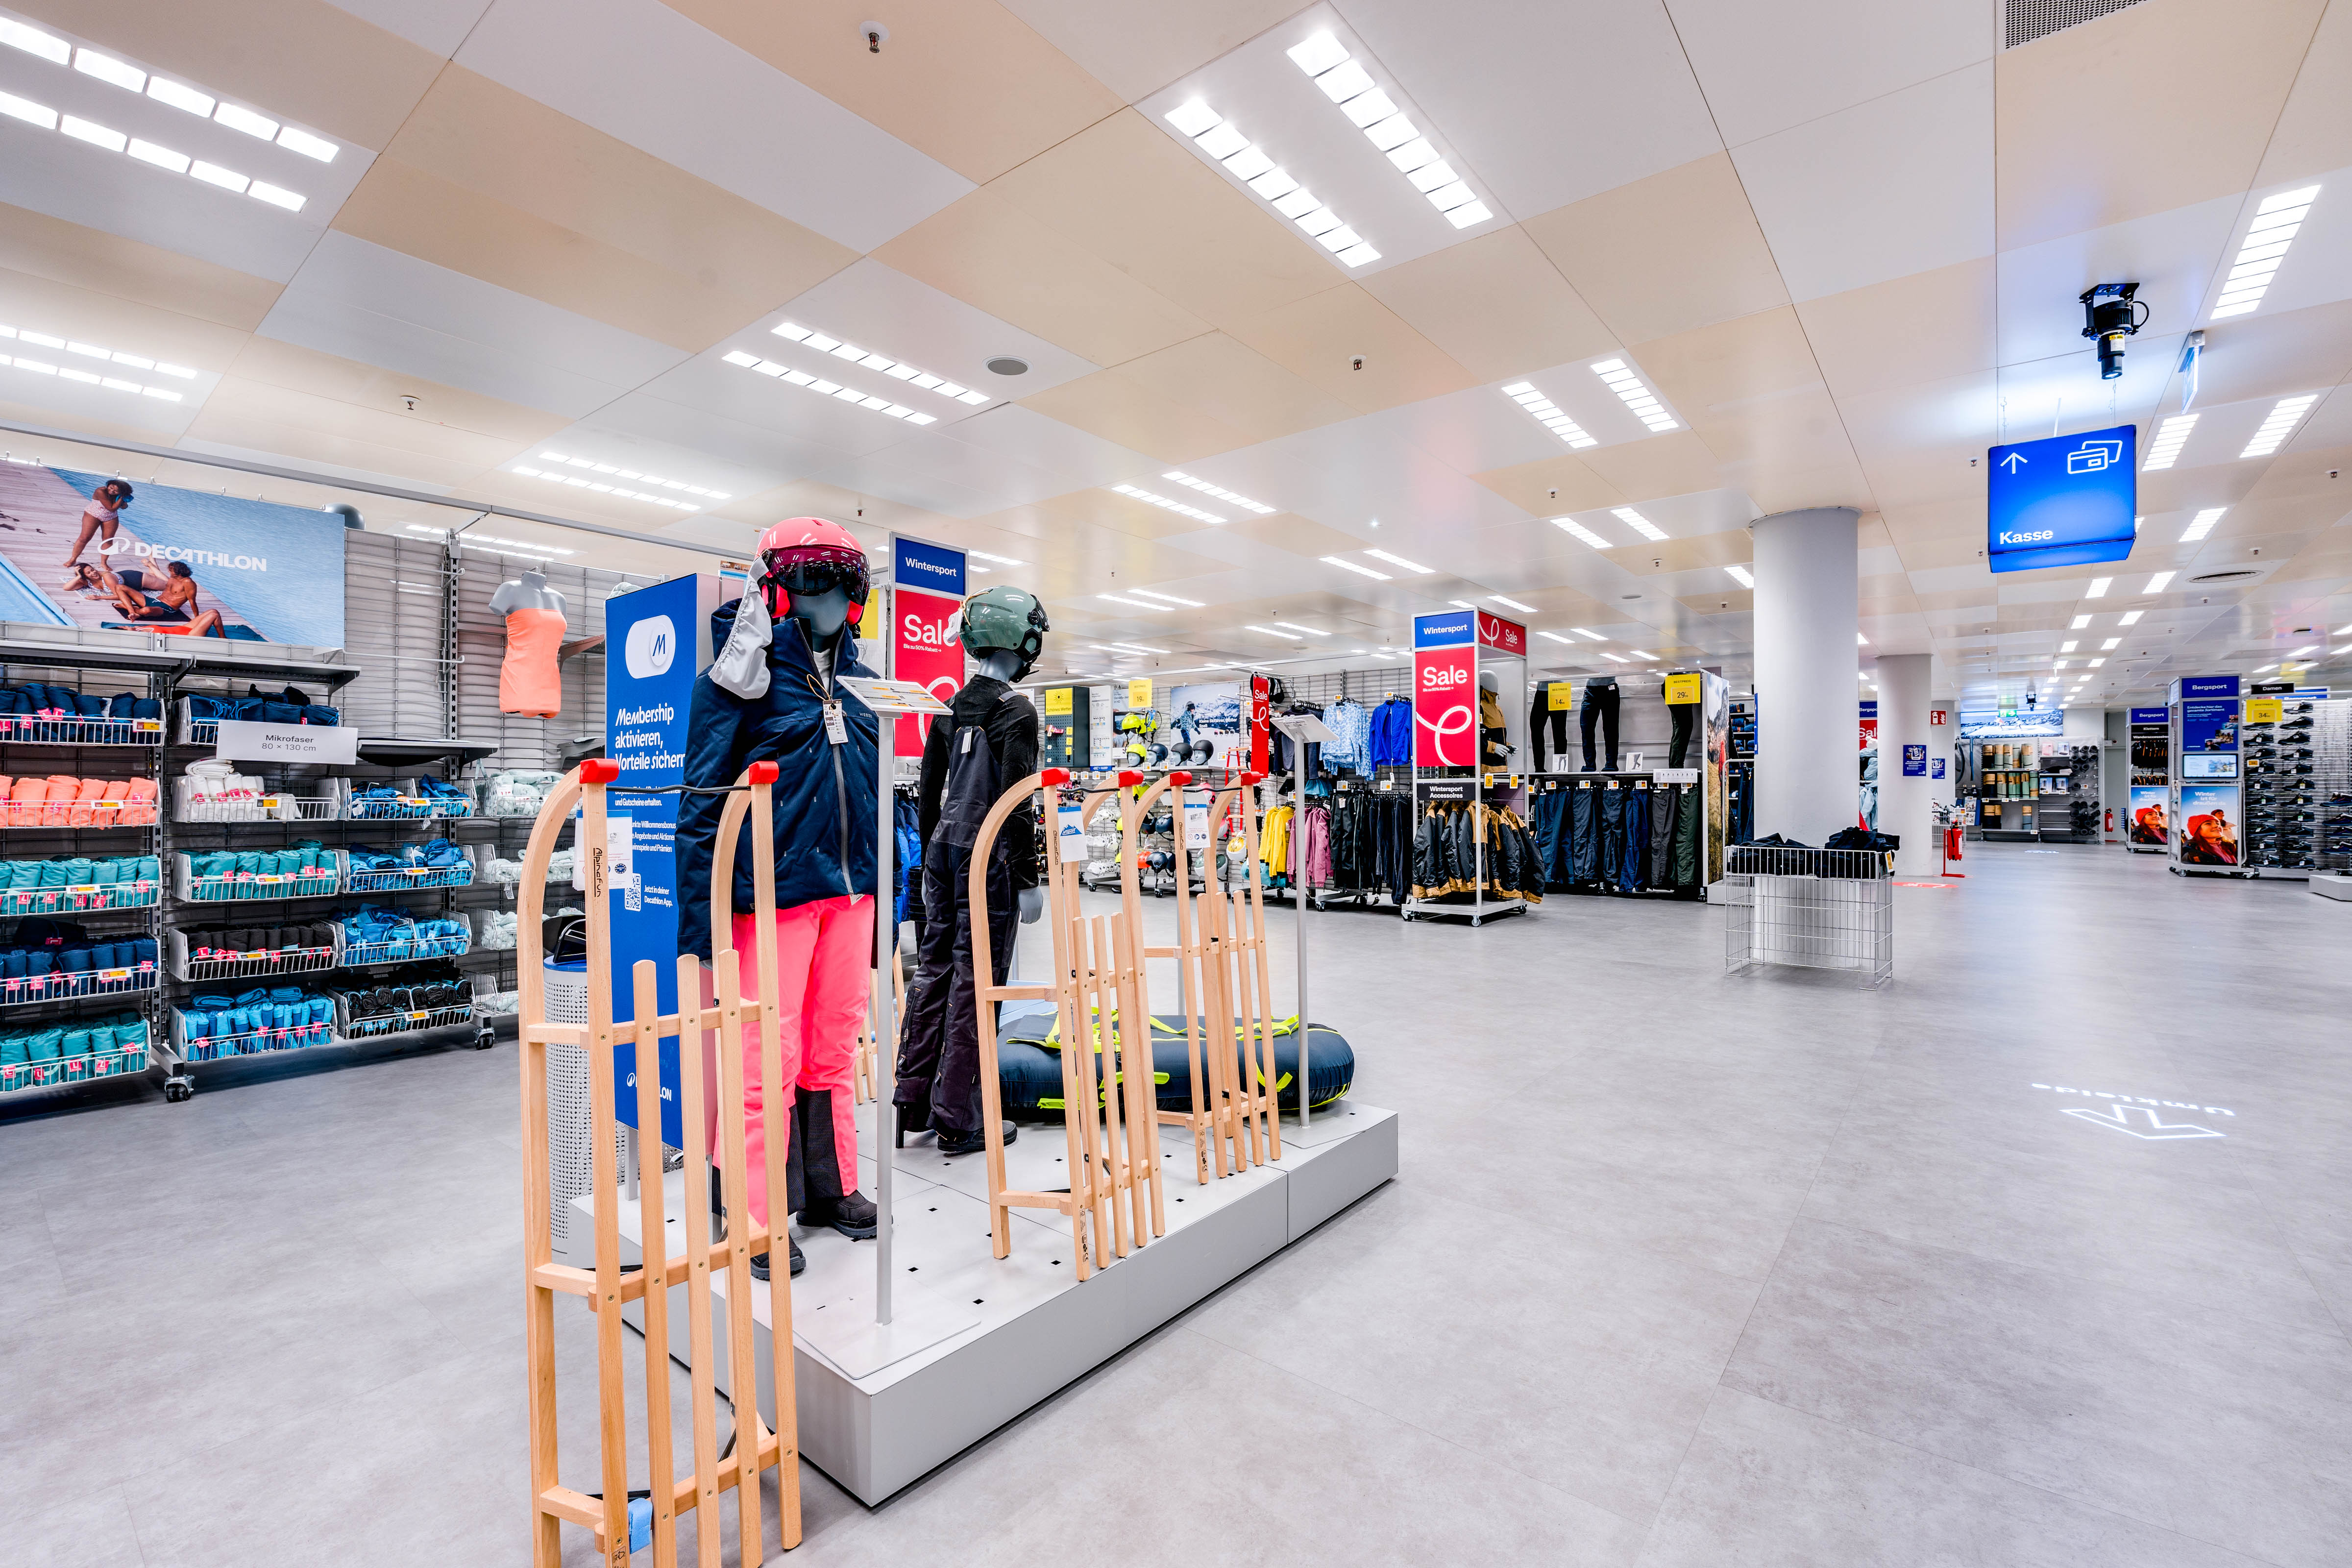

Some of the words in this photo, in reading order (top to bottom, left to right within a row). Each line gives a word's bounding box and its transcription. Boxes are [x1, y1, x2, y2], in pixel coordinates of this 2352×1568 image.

[2000, 529, 2053, 545] Kasse
[134, 541, 267, 572] DECATHLON
[905, 557, 957, 577] Wintersport
[1423, 624, 1468, 635] Wintersport
[1505, 629, 1518, 644] Sale
[1422, 665, 1468, 686] Sale
[1254, 689, 1268, 701] Sale
[615, 702, 674, 727] Membership
[1859, 727, 1877, 737] Sal
[265, 734, 314, 744] Mikrofaser
[615, 730, 663, 749] aktivieren,
[622, 798, 644, 806] Gutscheine
[645, 798, 662, 806] erhalten.
[641, 820, 676, 829] Willkommensbonus
[634, 832, 652, 841] Angebote
[657, 844, 672, 853] Prämien
[644, 885, 654, 893] Jetzt
[654, 885, 657, 894] in
[657, 886, 670, 895] deiner
[644, 895, 663, 906] Decathlon
[663, 898, 673, 908] App.
[2031, 1082, 2235, 1117] Umkleide
